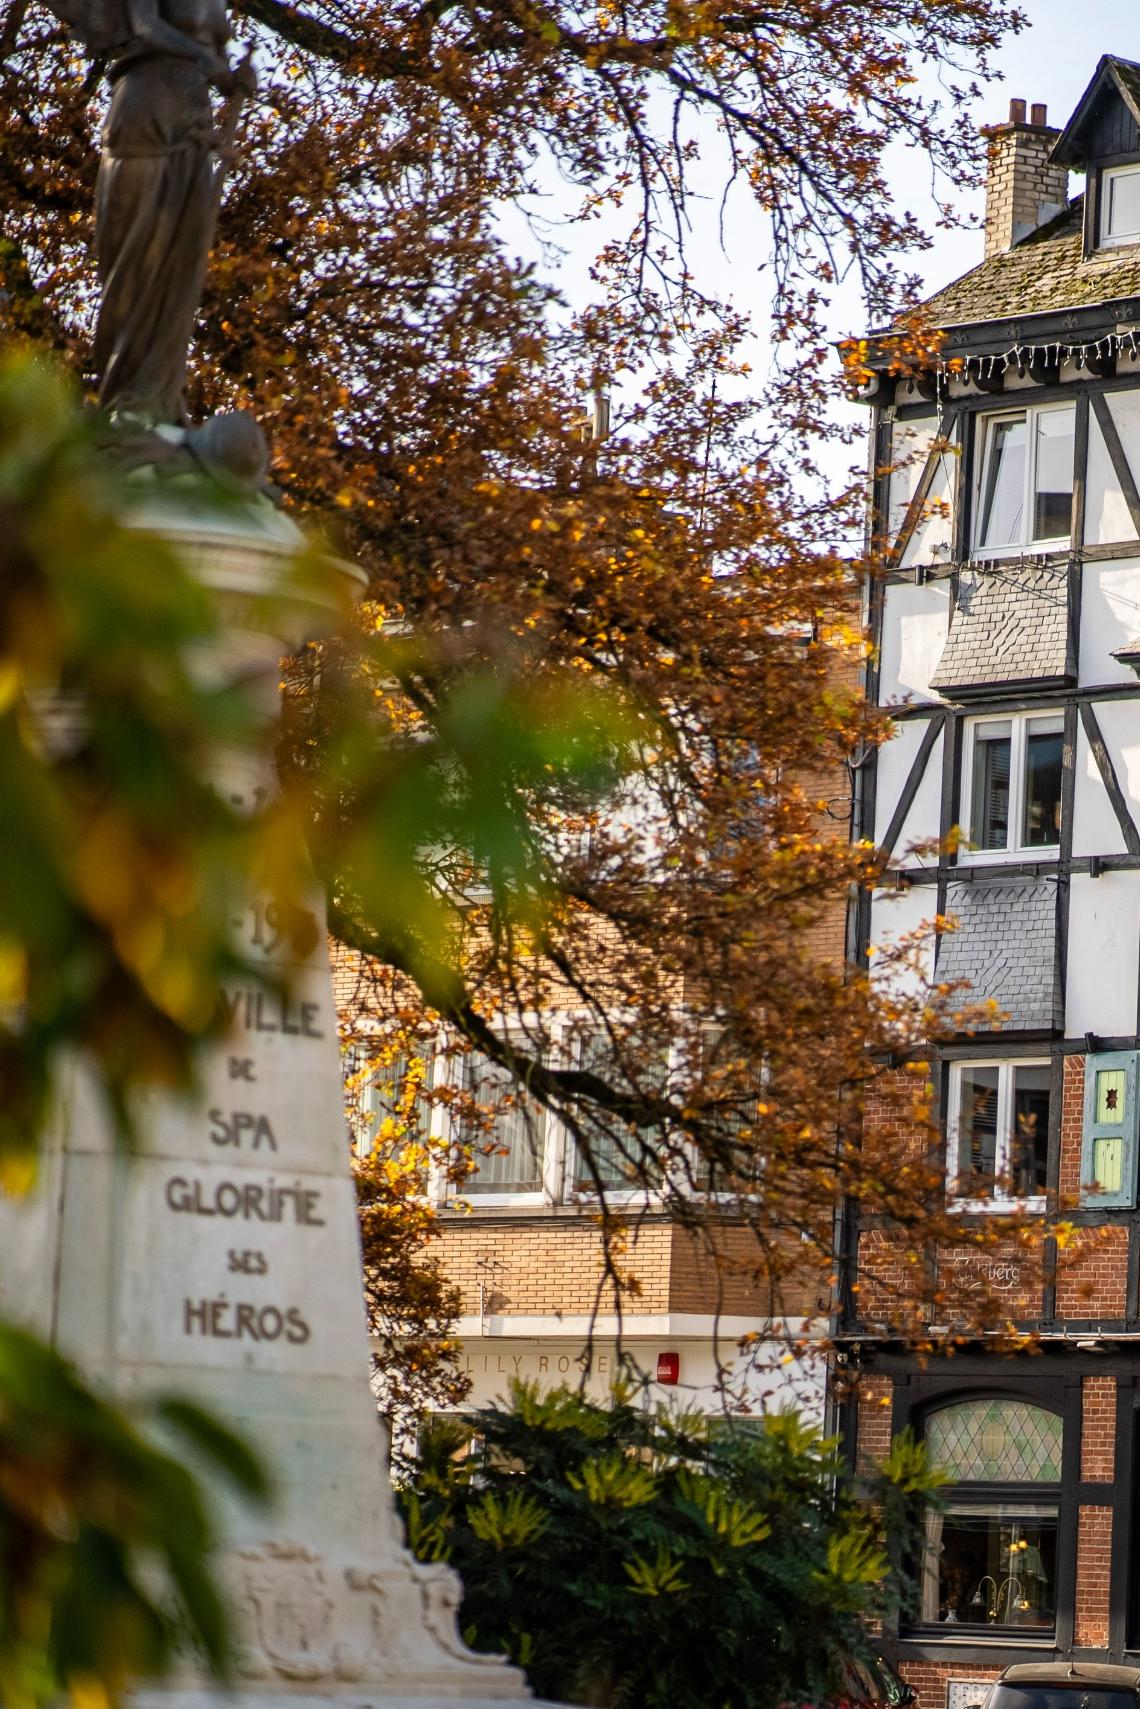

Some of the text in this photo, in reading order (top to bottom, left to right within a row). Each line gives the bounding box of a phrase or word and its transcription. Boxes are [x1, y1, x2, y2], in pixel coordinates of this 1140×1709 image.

[219, 988, 325, 1040] VILLE
[228, 1056, 257, 1083] DE
[208, 1109, 278, 1152] SPA
[228, 1249, 269, 1276] SES
[183, 1292, 311, 1346] HÉROS
[465, 1355, 608, 1373] LILY ROSE
